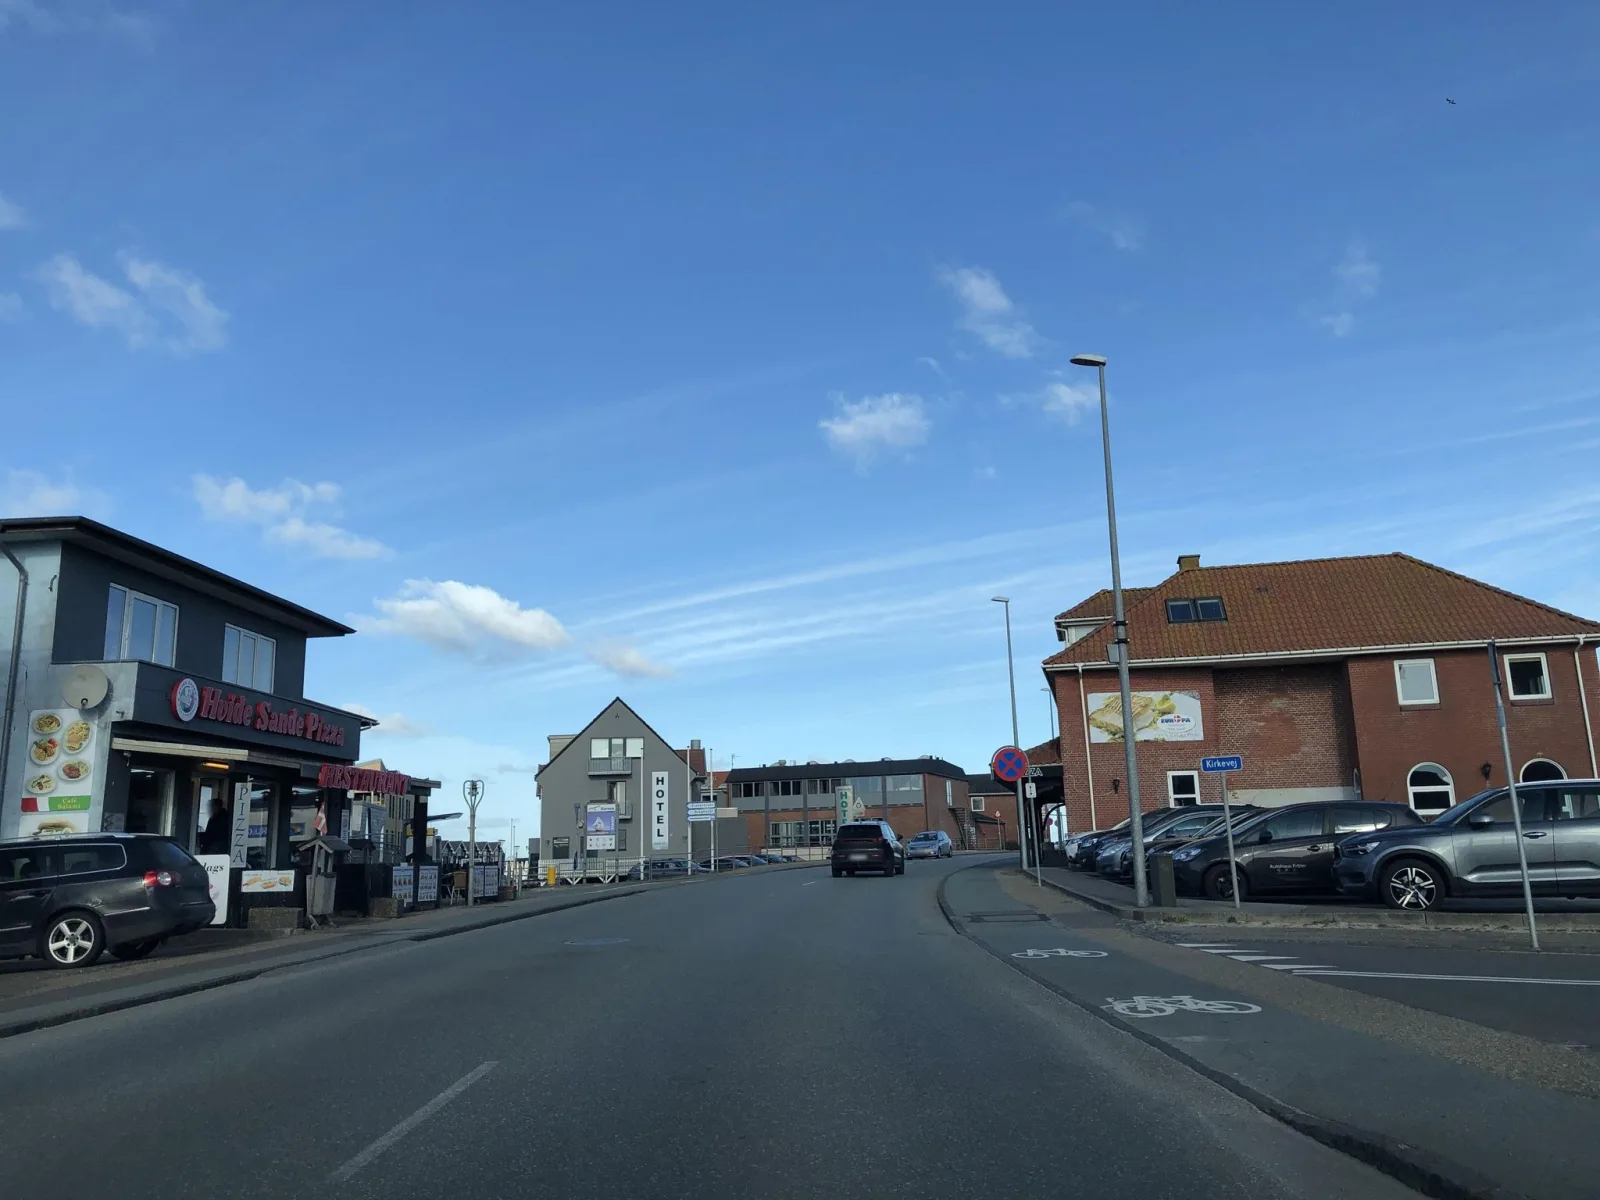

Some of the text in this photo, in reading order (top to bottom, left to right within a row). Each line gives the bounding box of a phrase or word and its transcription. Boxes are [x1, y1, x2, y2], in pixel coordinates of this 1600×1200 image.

[200, 687, 252, 726] Hvide
[255, 701, 304, 737] Sande
[304, 711, 345, 747] Pizza
[318, 763, 411, 796] RESTAURANT
[1205, 759, 1238, 769] Kirkevej
[232, 787, 249, 863] PIZZA
[656, 776, 664, 837] HOTEL
